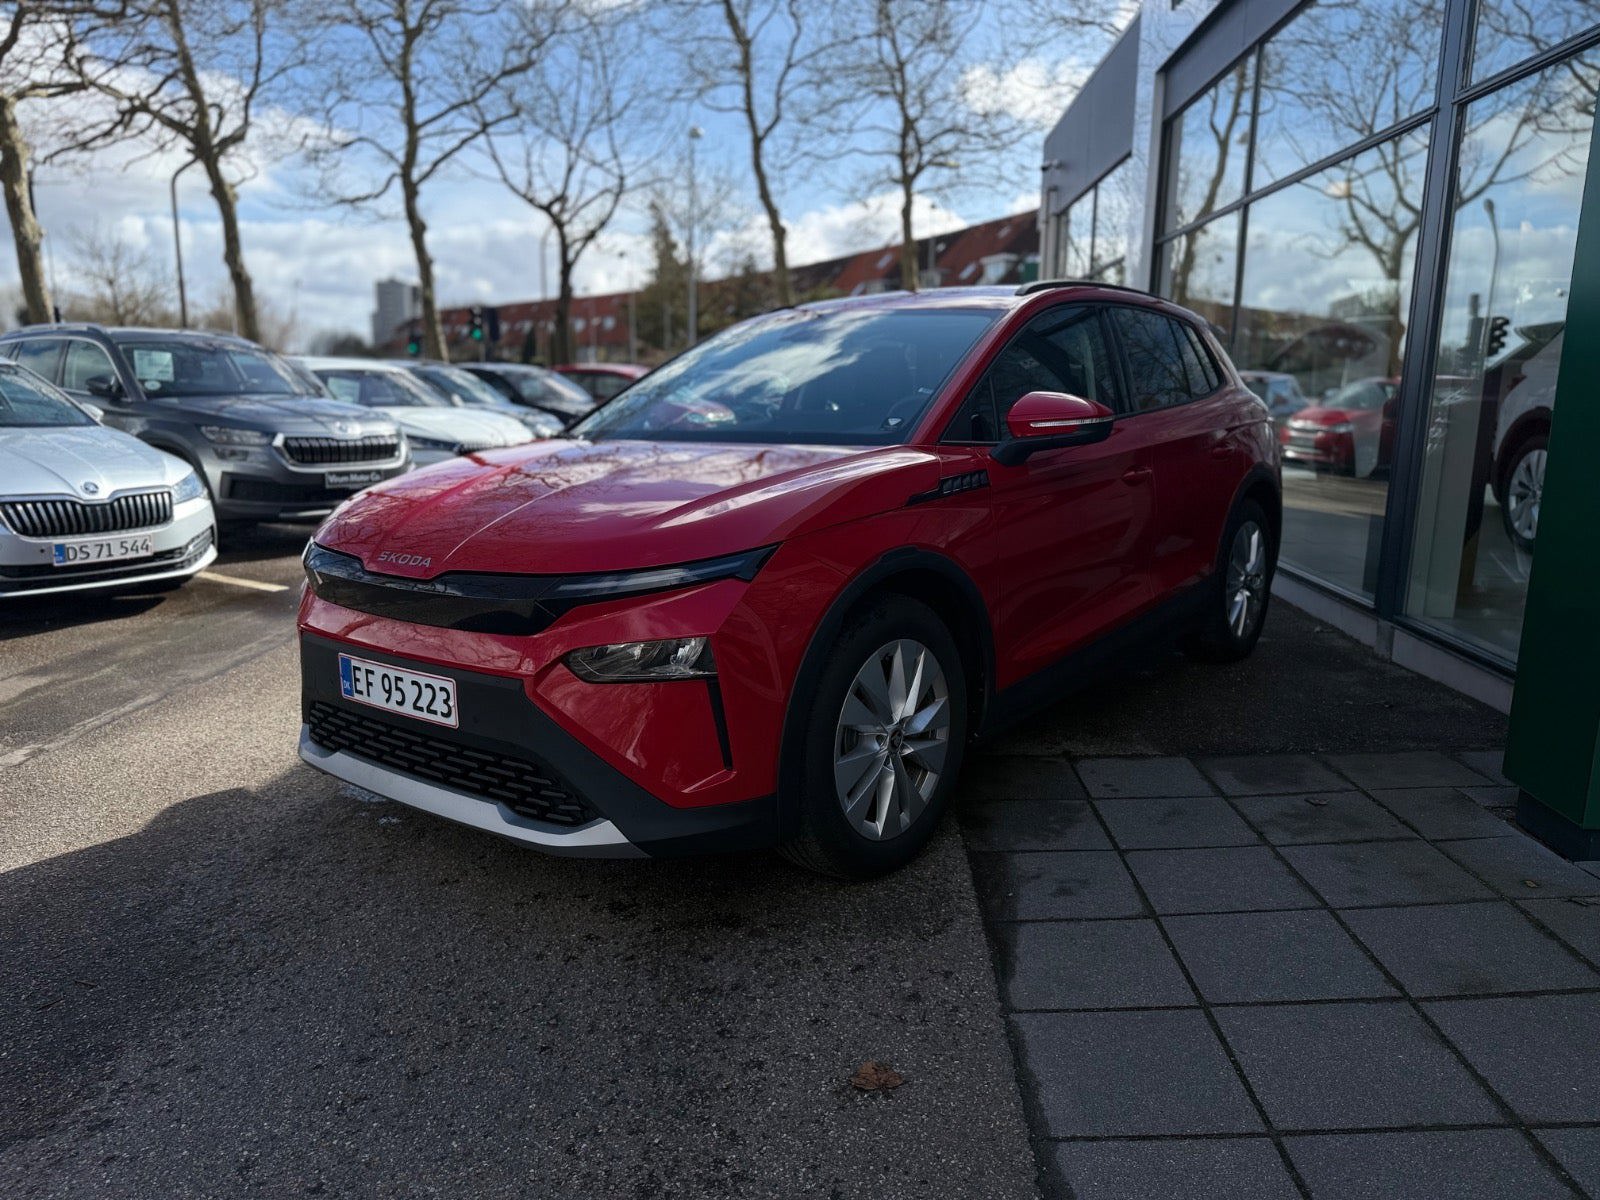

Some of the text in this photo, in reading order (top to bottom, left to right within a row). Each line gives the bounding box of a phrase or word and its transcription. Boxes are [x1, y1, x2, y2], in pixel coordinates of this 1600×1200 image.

[66, 538, 150, 561] DS 71 544
[352, 665, 452, 719] EF 95 223
